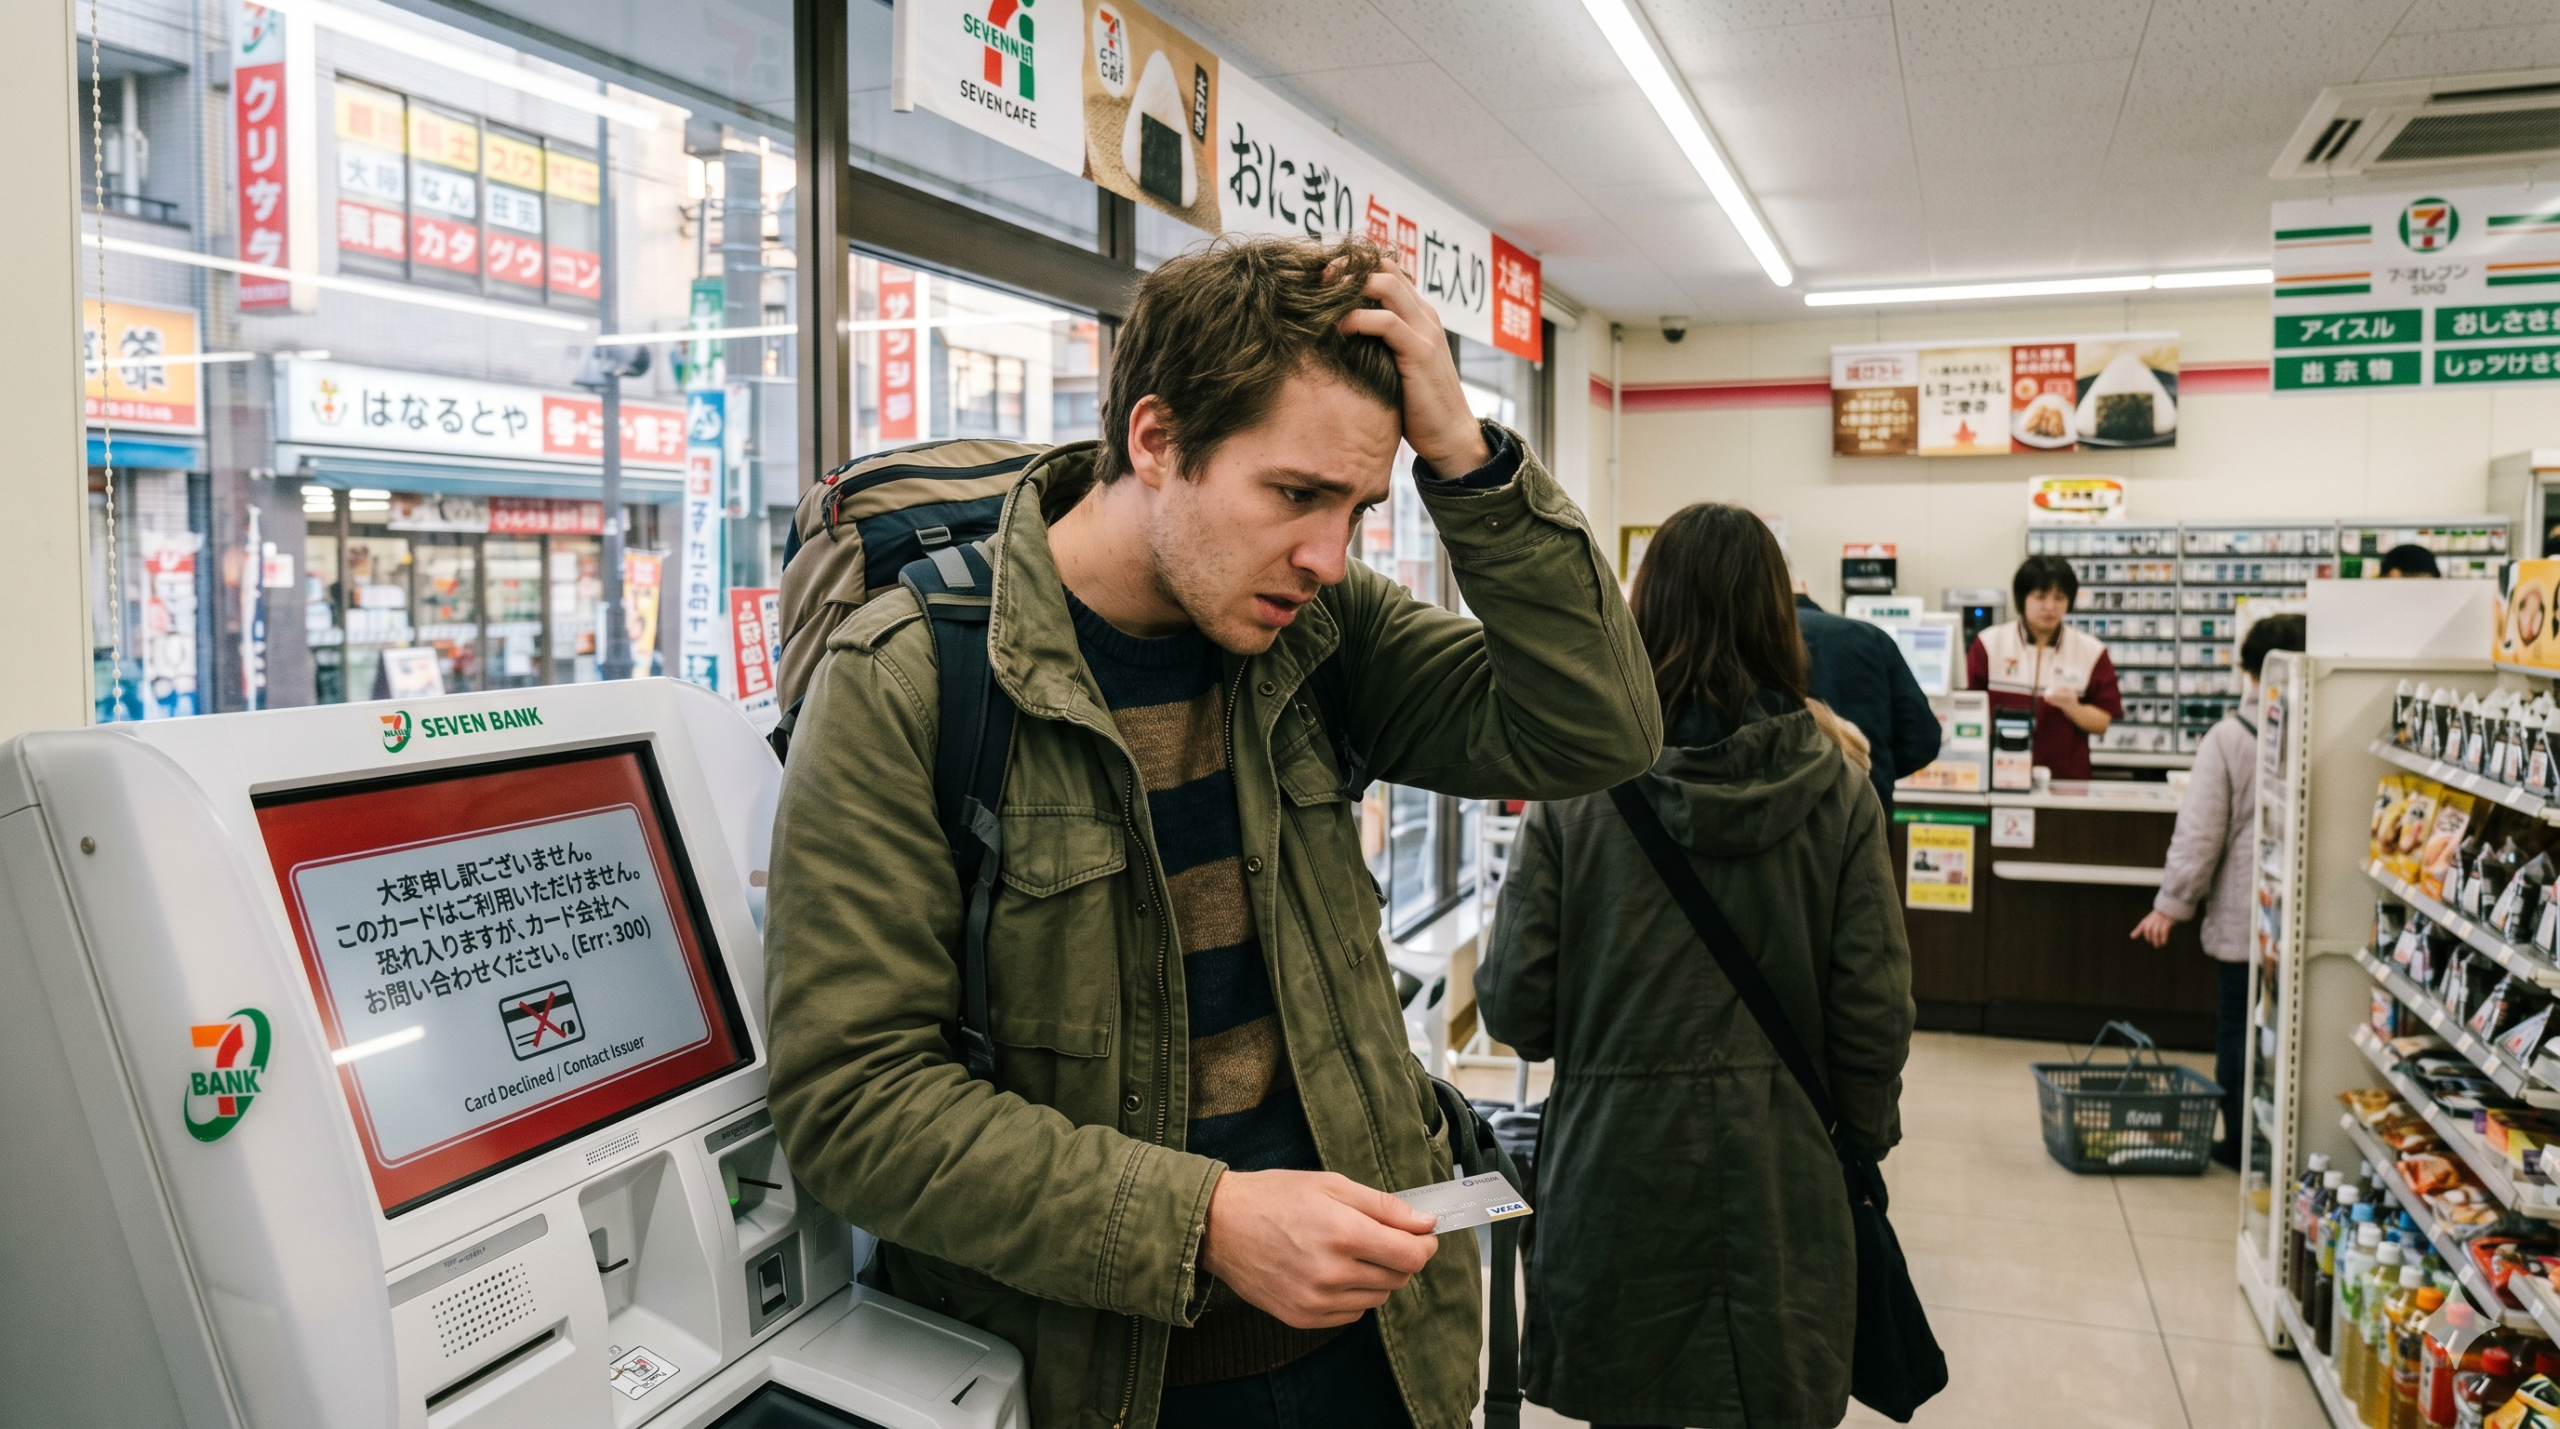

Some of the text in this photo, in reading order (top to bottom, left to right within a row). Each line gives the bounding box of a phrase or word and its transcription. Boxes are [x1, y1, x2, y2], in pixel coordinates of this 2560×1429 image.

[960, 80, 1037, 129] SEVEN CAFE
[2300, 317, 2396, 342] アイスル
[363, 387, 529, 440] はなるとや
[421, 713, 488, 738] SEVEN
[488, 706, 544, 731] BANK
[376, 841, 593, 907] 大変申し訳ございません。
[335, 861, 641, 949] このカードはご利用いただけません。
[374, 895, 630, 977] 恐れ入りますが、カード会社へ
[191, 1069, 262, 1096] BANK
[464, 1087, 498, 1112] Card
[498, 1067, 555, 1100] Declined
[563, 1048, 611, 1076] Contact
[610, 1036, 645, 1059] Issuer
